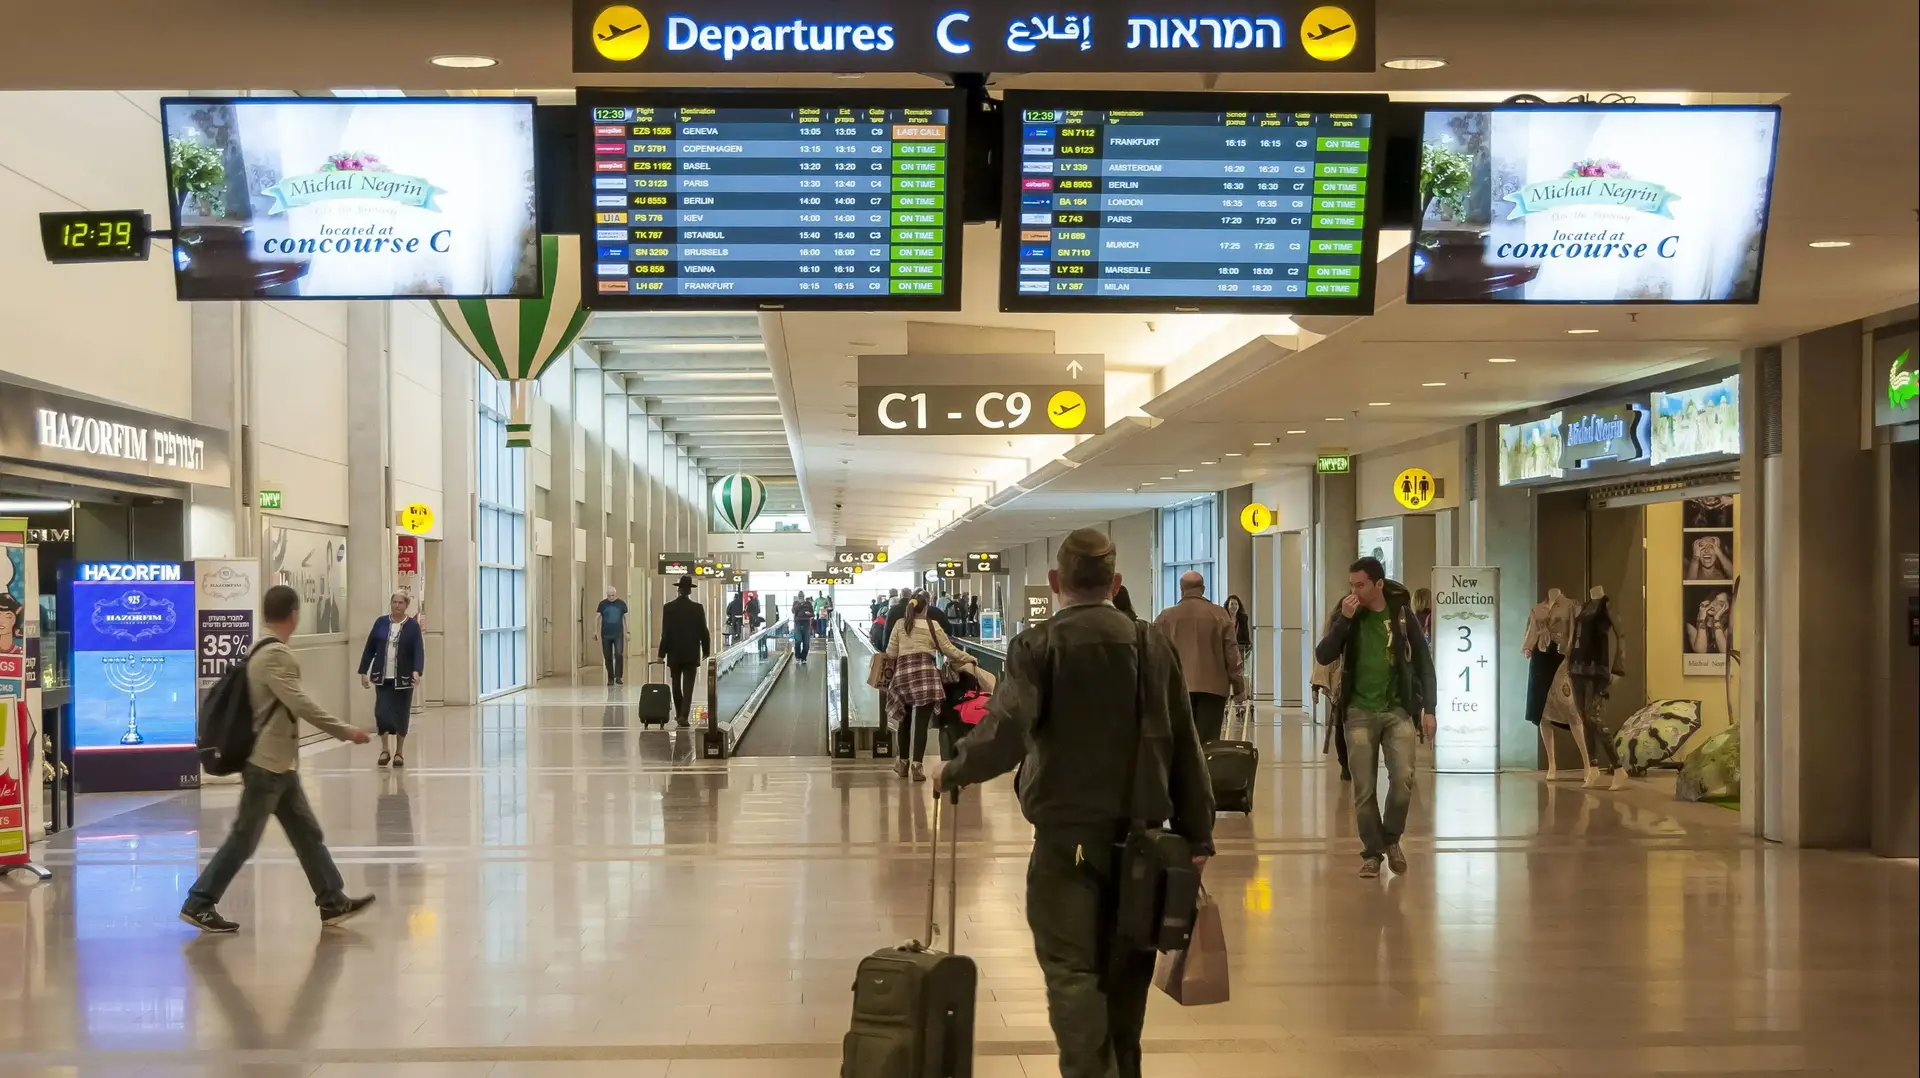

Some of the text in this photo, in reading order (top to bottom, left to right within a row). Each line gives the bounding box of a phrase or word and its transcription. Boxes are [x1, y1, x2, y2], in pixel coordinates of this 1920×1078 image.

[668, 13, 971, 61] Departures C
[1007, 15, 1092, 52] إقلاع
[1127, 18, 1282, 49] המראות
[597, 109, 625, 119] 12:39
[1027, 111, 1054, 121] 12:39
[633, 127, 941, 137] EZS GENEVA 13:05 13:05 LAST CALL
[633, 144, 646, 153] DY
[682, 144, 743, 154] COPENHAGEN
[799, 145, 821, 154] 13:15
[834, 145, 857, 154] 13:15
[900, 145, 915, 154] ON
[915, 145, 936, 154] TIME
[1109, 138, 1360, 149] FRANKFURT ON TIME
[633, 162, 652, 171] EZS
[682, 162, 711, 171] BASEL
[799, 162, 821, 171] 13:20
[834, 162, 856, 171] 13:20
[900, 162, 914, 171] ON
[915, 162, 936, 171] TIME
[1108, 163, 1360, 175] AMSTERDAM ON TIME
[290, 173, 423, 199] Michal Negrin
[634, 179, 647, 188] TO
[683, 179, 710, 188] PARIS
[799, 180, 821, 189] 13:30
[834, 180, 856, 189] 13:40
[899, 180, 914, 189] ON
[915, 180, 936, 189] TIME
[1108, 180, 1357, 192] BERLIN ON TIME
[1531, 179, 1659, 205] Michal Negrin
[634, 196, 935, 206] 4U BERLIN 14:00 14:00 ON TIME
[1107, 198, 1356, 209] LONDON ON TIME
[603, 213, 621, 222] UIA
[634, 214, 935, 223] PS KIEV 14:00 14:00 ON TIME
[1107, 215, 1355, 226] PARIS ON TIME
[64, 221, 131, 247] 12:39
[320, 224, 394, 236] located at
[634, 231, 935, 240] TK ISTANBUL 15:40 15:40 ON TIME
[1553, 229, 1625, 241] located at
[263, 229, 452, 254] concourse C
[1105, 240, 1353, 251] MUNICH ON TIME
[1497, 235, 1680, 259] concourse C
[635, 248, 934, 257] SN BRUSSELS ON TIME
[635, 265, 934, 274] OS VIENNA ON TIME
[1104, 265, 1351, 276] MARSEILLE ON TIME
[636, 282, 648, 291] LH
[684, 282, 734, 291] FRANKFURT
[898, 282, 912, 291] ON
[913, 282, 934, 291] TIME
[1104, 282, 1350, 293] MILAN ON TIME
[877, 392, 927, 430] C1
[975, 391, 1032, 430] C9
[39, 409, 147, 462] HAZORFIM
[1567, 414, 1624, 452] Michal Negrin
[153, 429, 205, 471] הצורפים
[260, 492, 280, 507] יציאה
[839, 552, 853, 563] C6
[860, 552, 874, 563] C9
[85, 564, 181, 581] HAZORFIM
[828, 566, 839, 574] C6
[843, 566, 853, 574] C9
[945, 569, 955, 577] C3
[977, 562, 991, 572] C2
[1451, 574, 1479, 588] New
[127, 595, 141, 605] 925
[1436, 591, 1495, 605] Collection
[203, 634, 248, 656] 35%
[1456, 625, 1473, 653] 3
[1476, 654, 1489, 669] +
[1457, 665, 1471, 693] 1
[1451, 697, 1479, 712] free
